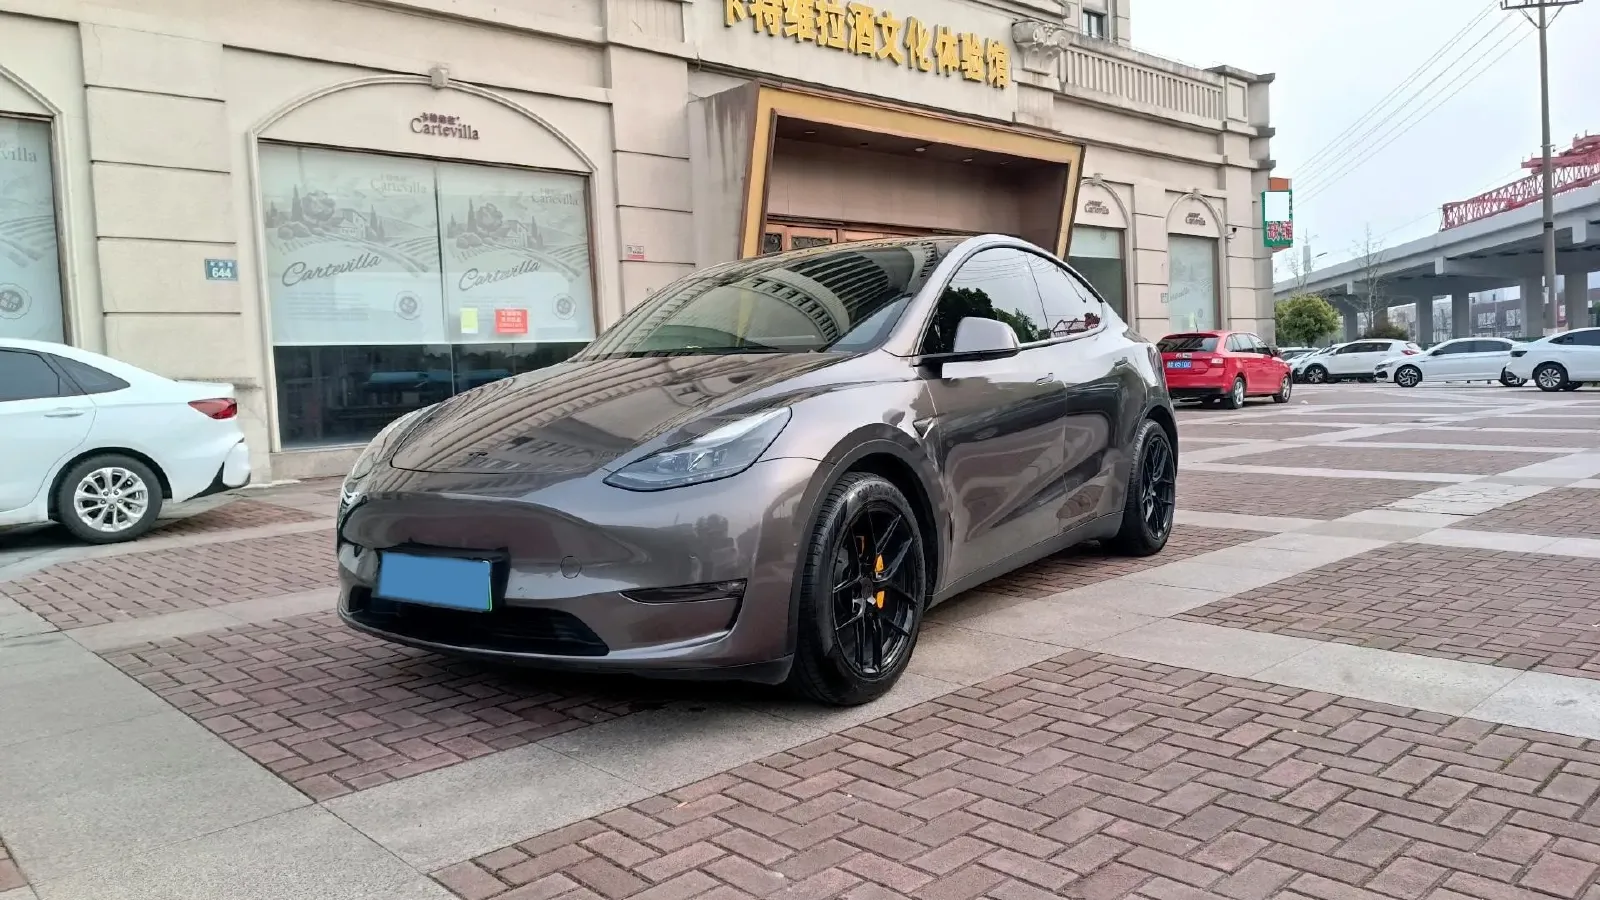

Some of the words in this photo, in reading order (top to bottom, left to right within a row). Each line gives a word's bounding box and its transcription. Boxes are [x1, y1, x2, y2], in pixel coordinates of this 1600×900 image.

[410, 118, 479, 140] Cartevilla
[212, 267, 231, 278] 644
[281, 252, 382, 288] Cartevilla
[458, 259, 541, 291] Cartevilla
